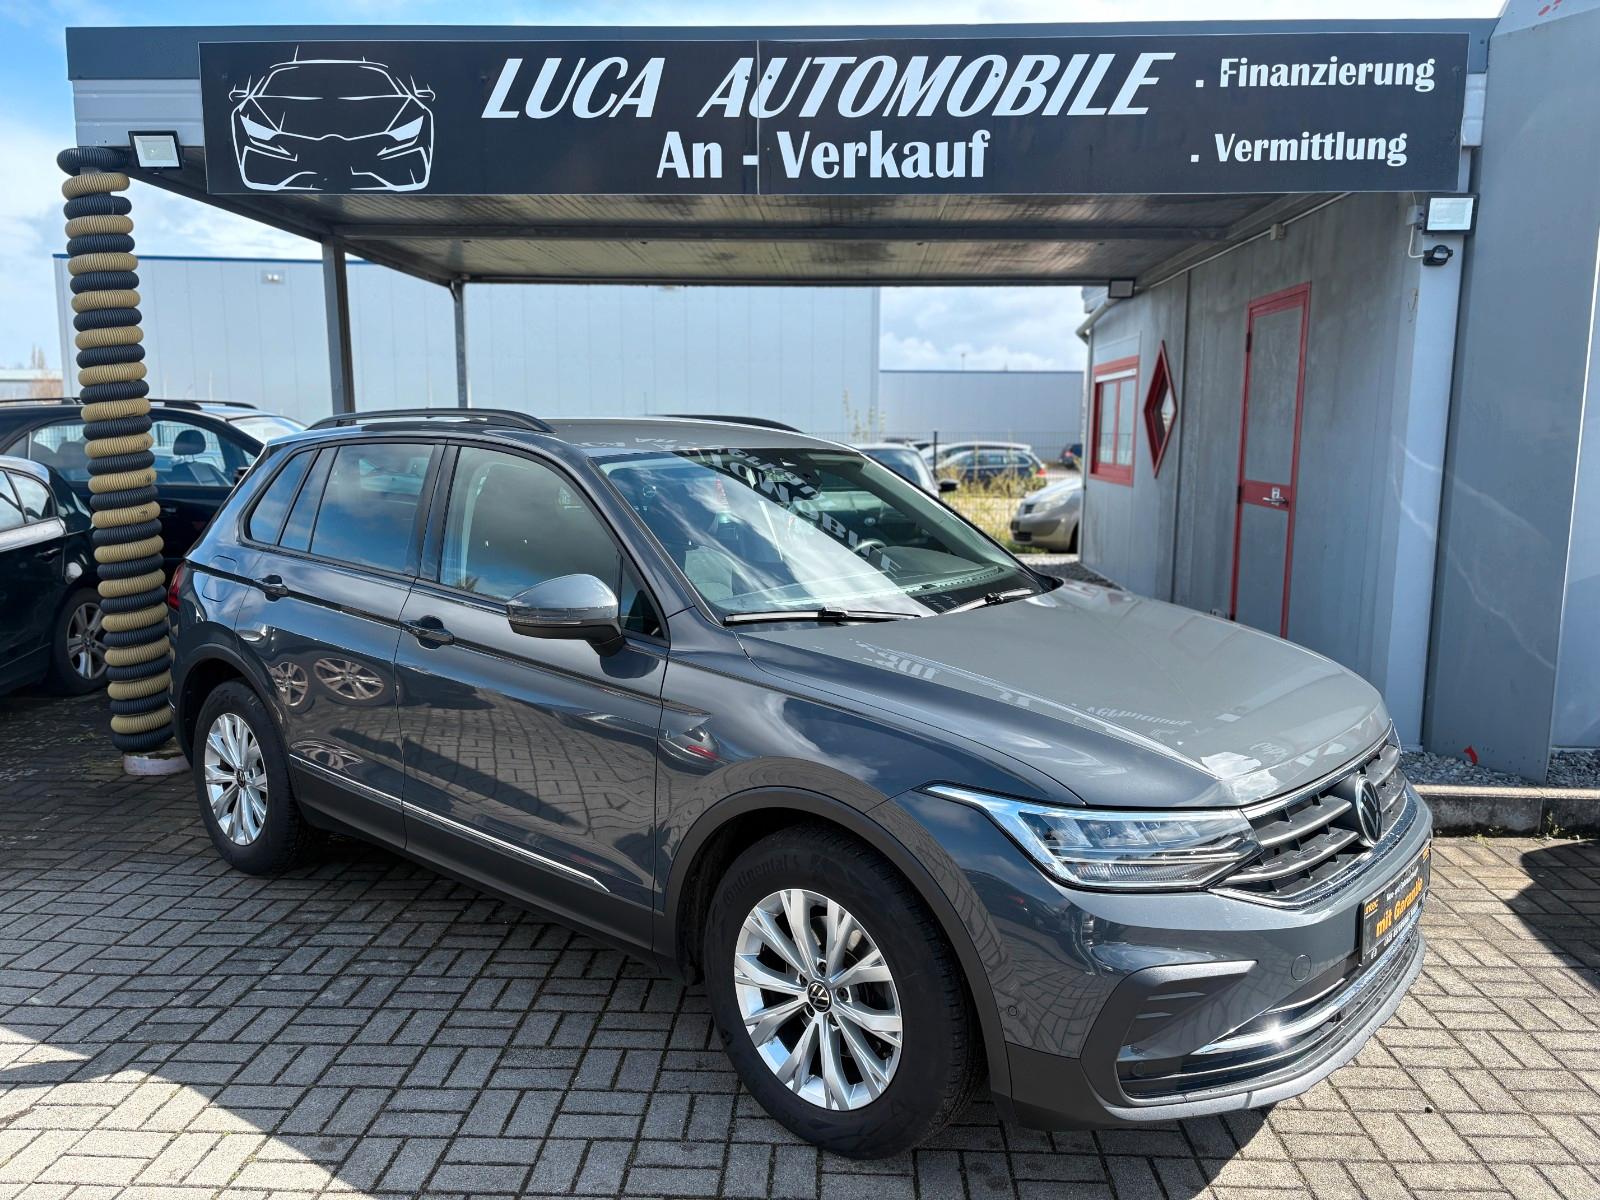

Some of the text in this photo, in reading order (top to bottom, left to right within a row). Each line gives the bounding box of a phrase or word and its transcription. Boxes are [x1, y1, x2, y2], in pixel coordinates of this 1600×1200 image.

[481, 52, 1176, 119] LUCA AUTOMOBILE
[1220, 55, 1436, 93] Finanzierung
[656, 130, 723, 179] An
[776, 129, 991, 179] Verkauf
[1214, 131, 1408, 167] Vermittlung
[1375, 907, 1393, 939] mit
